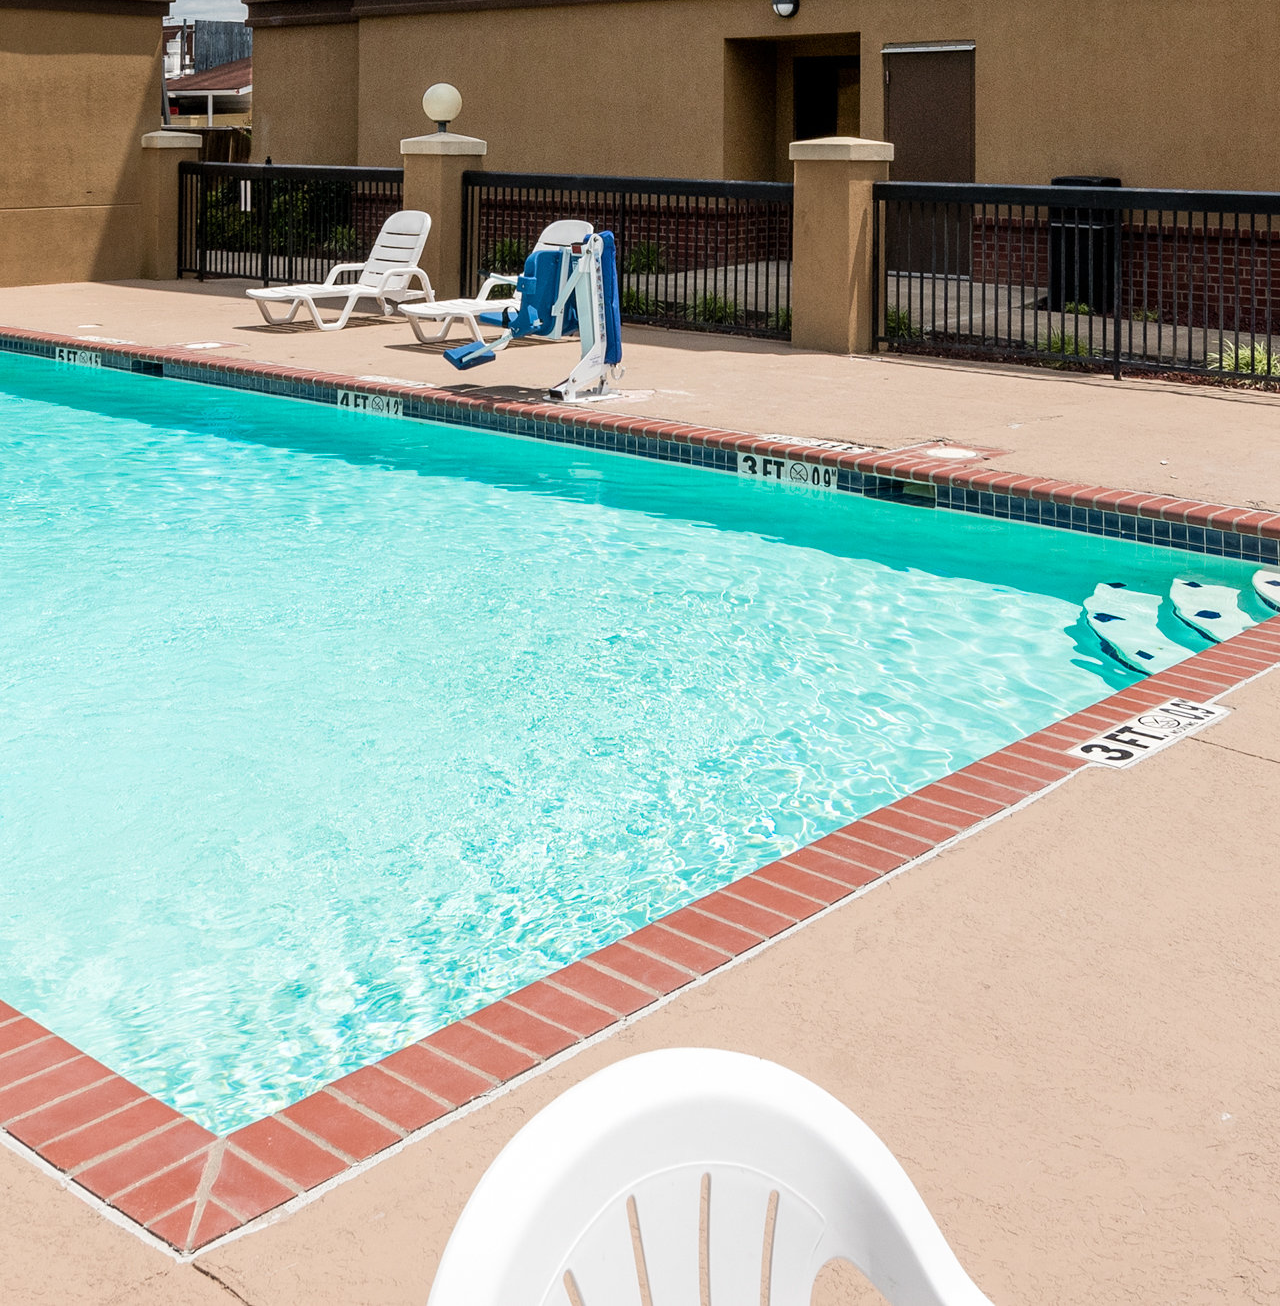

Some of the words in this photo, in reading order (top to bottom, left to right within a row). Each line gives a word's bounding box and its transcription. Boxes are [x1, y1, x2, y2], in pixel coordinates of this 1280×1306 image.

[340, 392, 350, 407] 4
[354, 394, 369, 410] FT
[742, 455, 757, 474] 3
[763, 458, 785, 479] FT
[1081, 744, 1134, 761] 3
